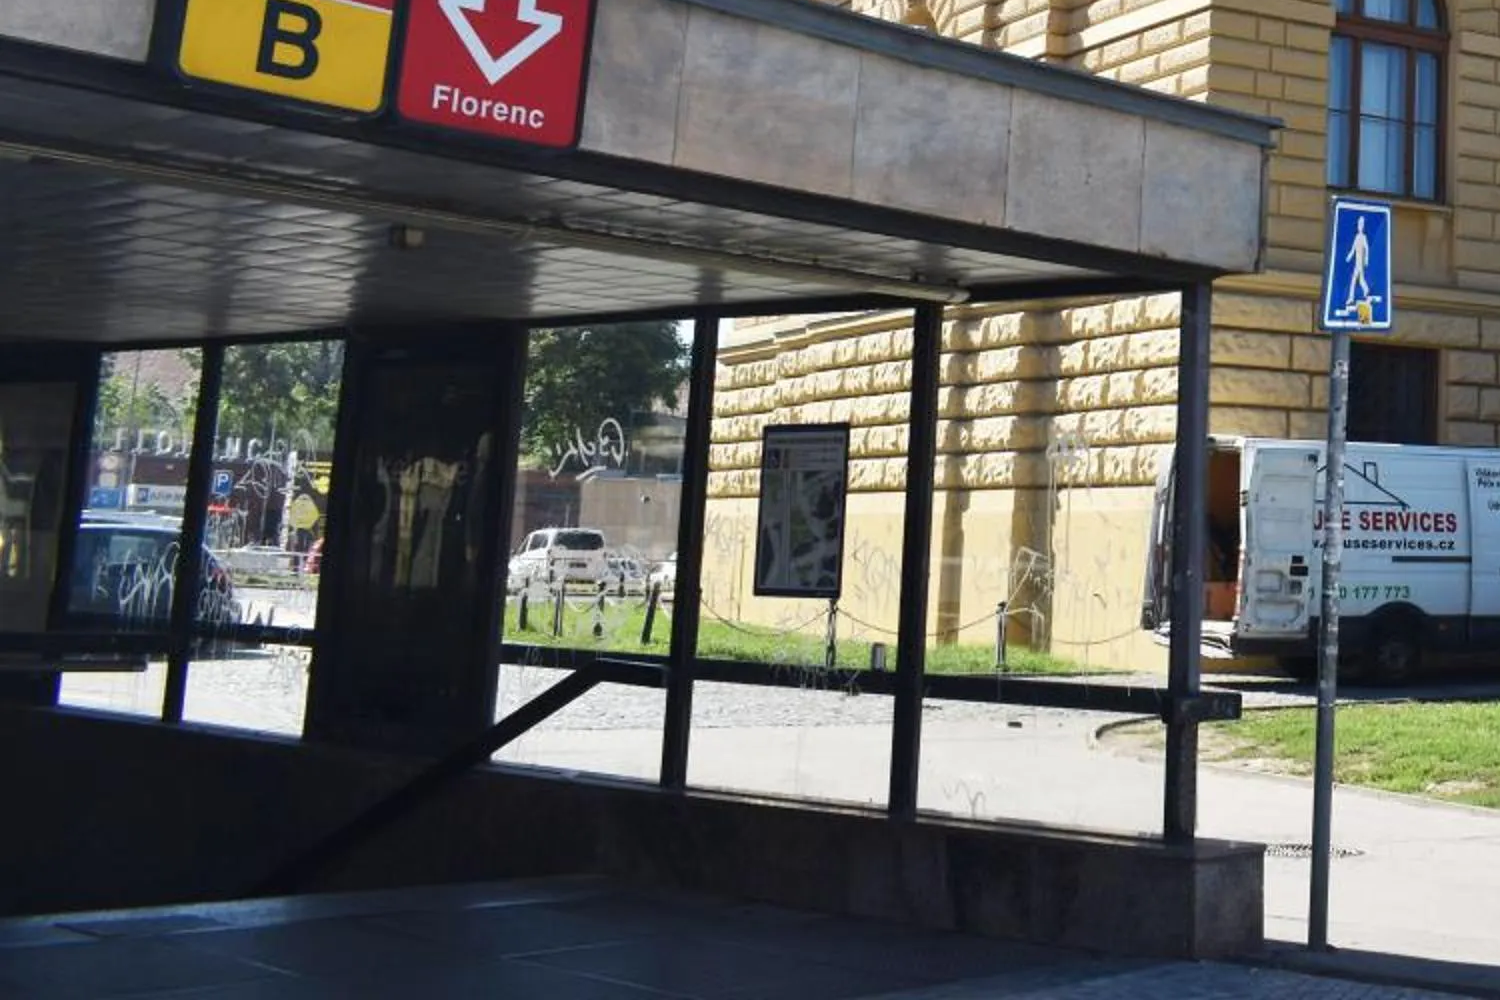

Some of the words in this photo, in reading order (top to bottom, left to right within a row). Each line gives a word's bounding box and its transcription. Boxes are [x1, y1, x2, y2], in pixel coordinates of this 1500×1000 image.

[432, 84, 545, 129] Florenc
[217, 473, 229, 488] P
[1359, 510, 1458, 533] SERVICES
[1352, 584, 1379, 599] 177
[1384, 585, 1410, 599] 773
